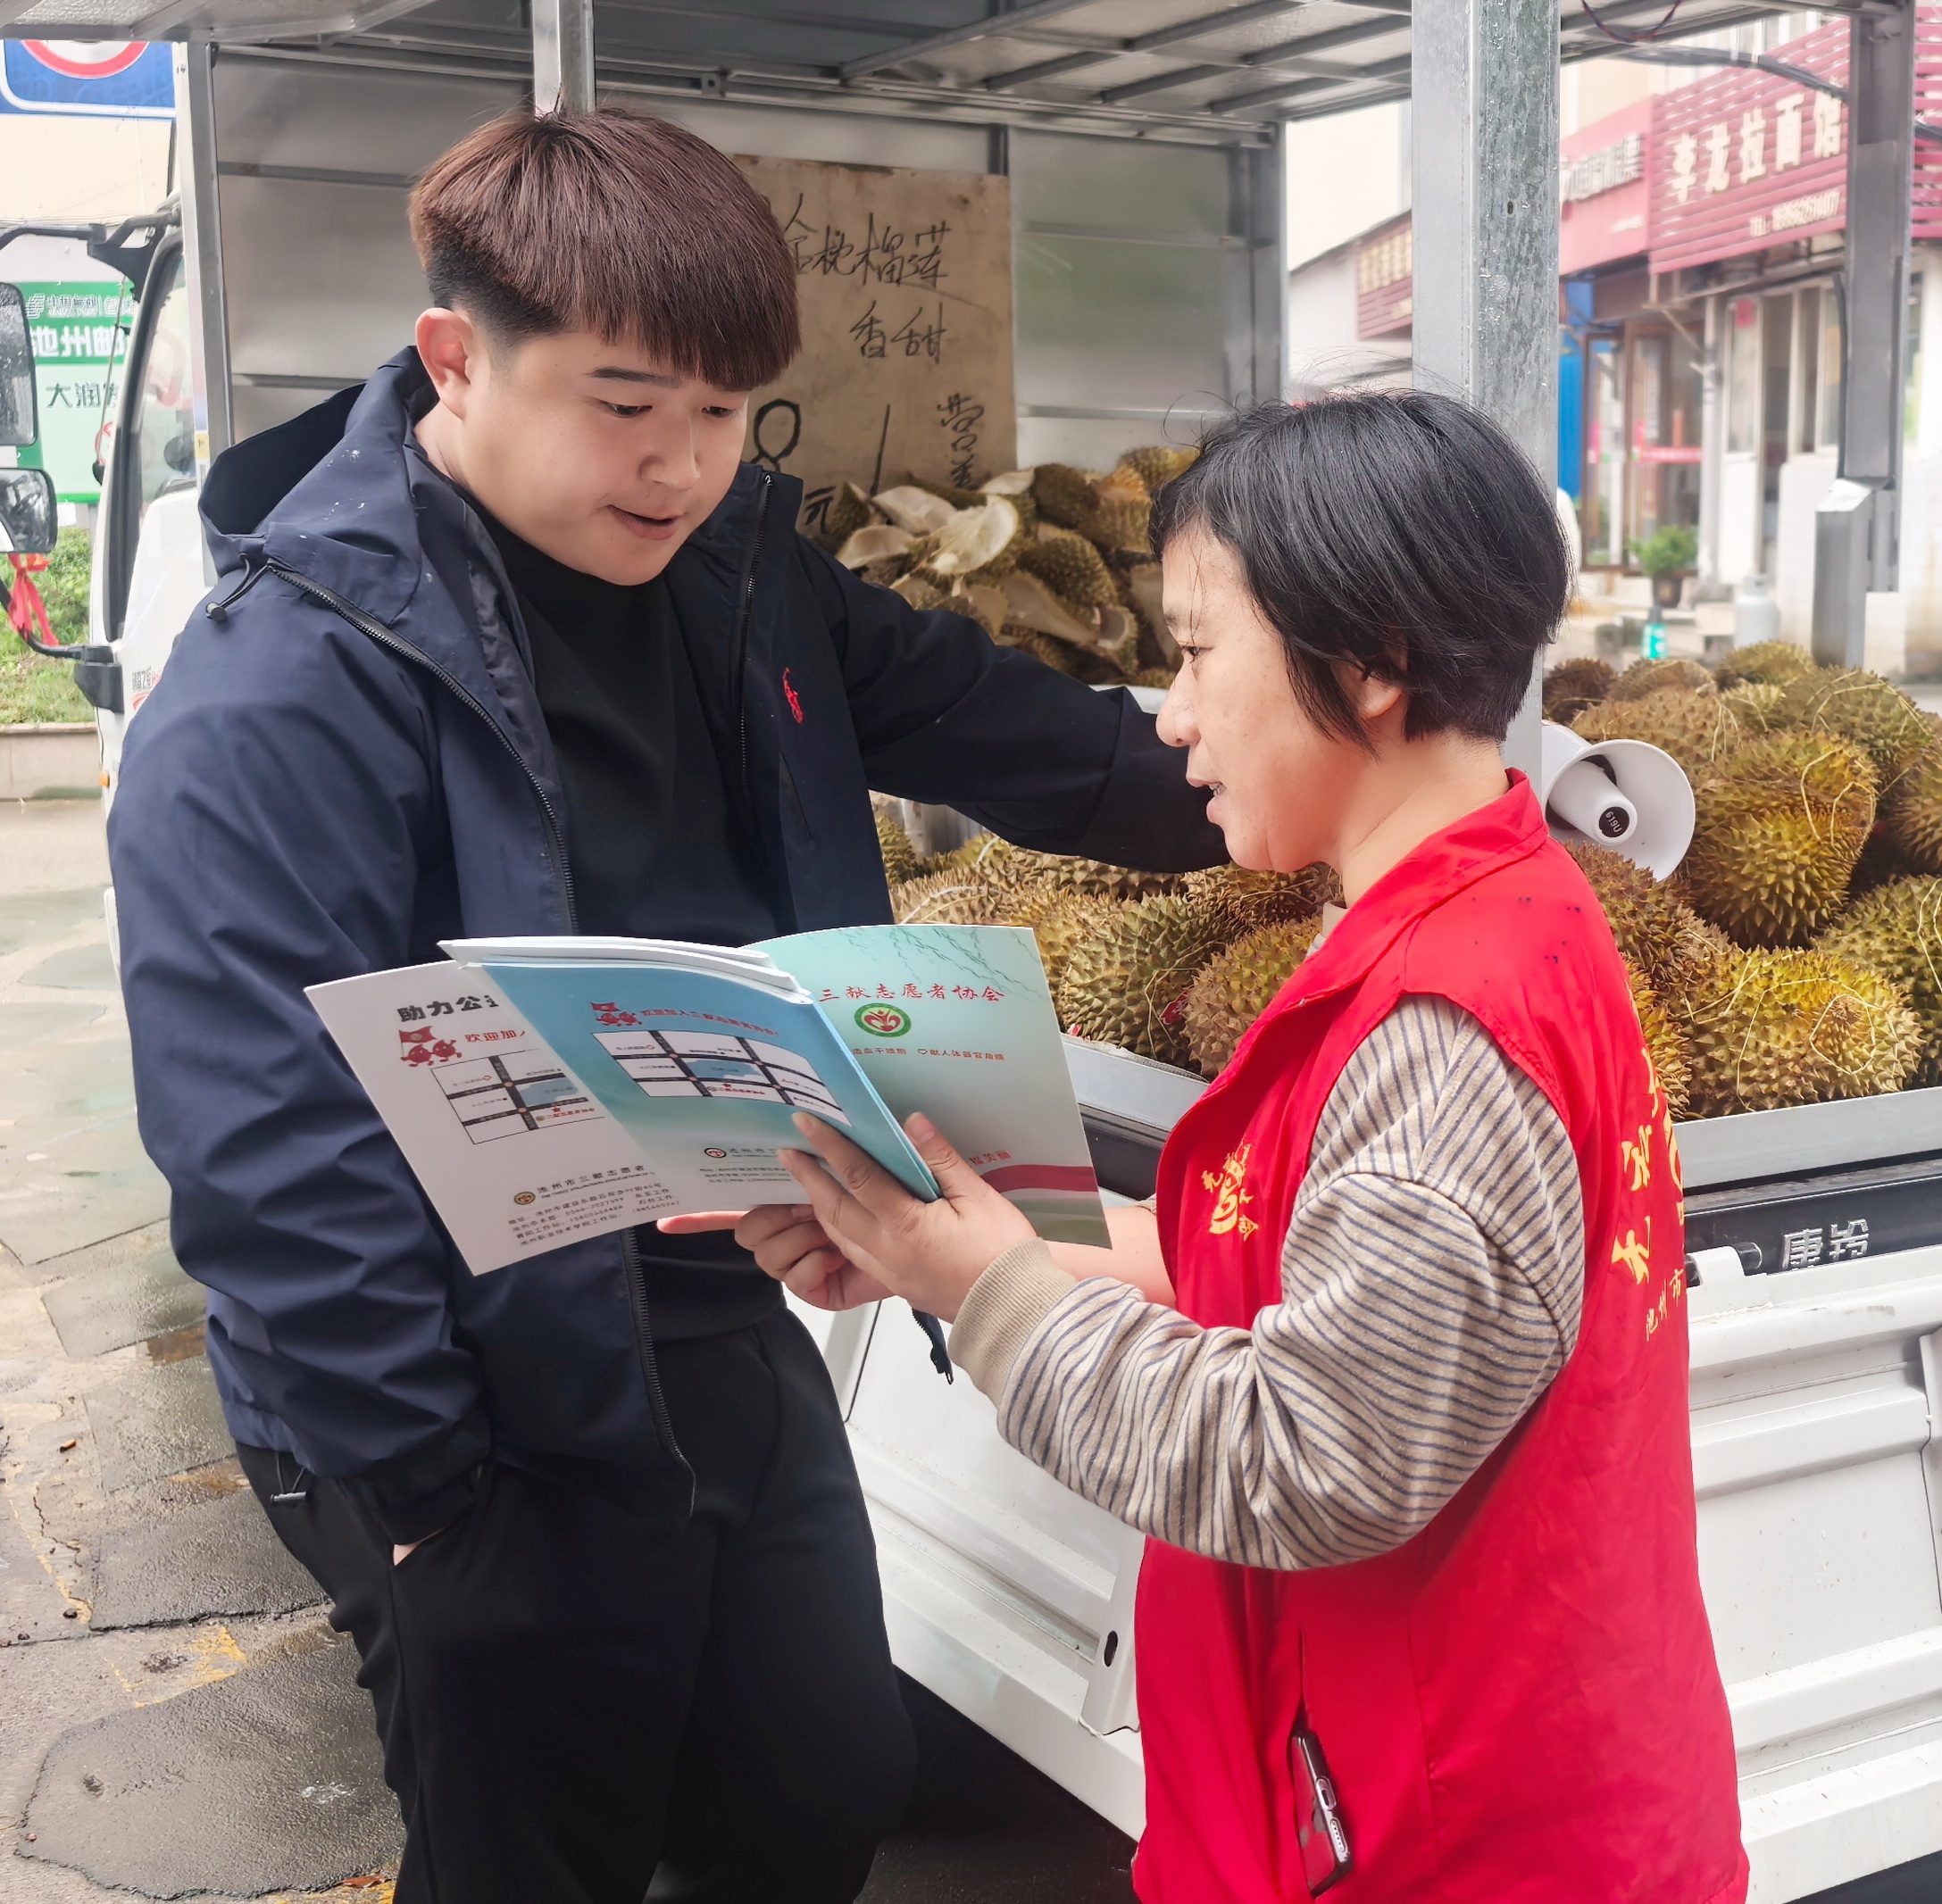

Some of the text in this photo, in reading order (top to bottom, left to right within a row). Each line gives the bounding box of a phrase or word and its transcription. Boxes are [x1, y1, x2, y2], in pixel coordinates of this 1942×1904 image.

[849, 300, 946, 364] 香甜
[1604, 811, 1623, 834] 619U
[819, 983, 1005, 1002] 三献志愿者协会
[1781, 1218, 1870, 1271] 康铃
